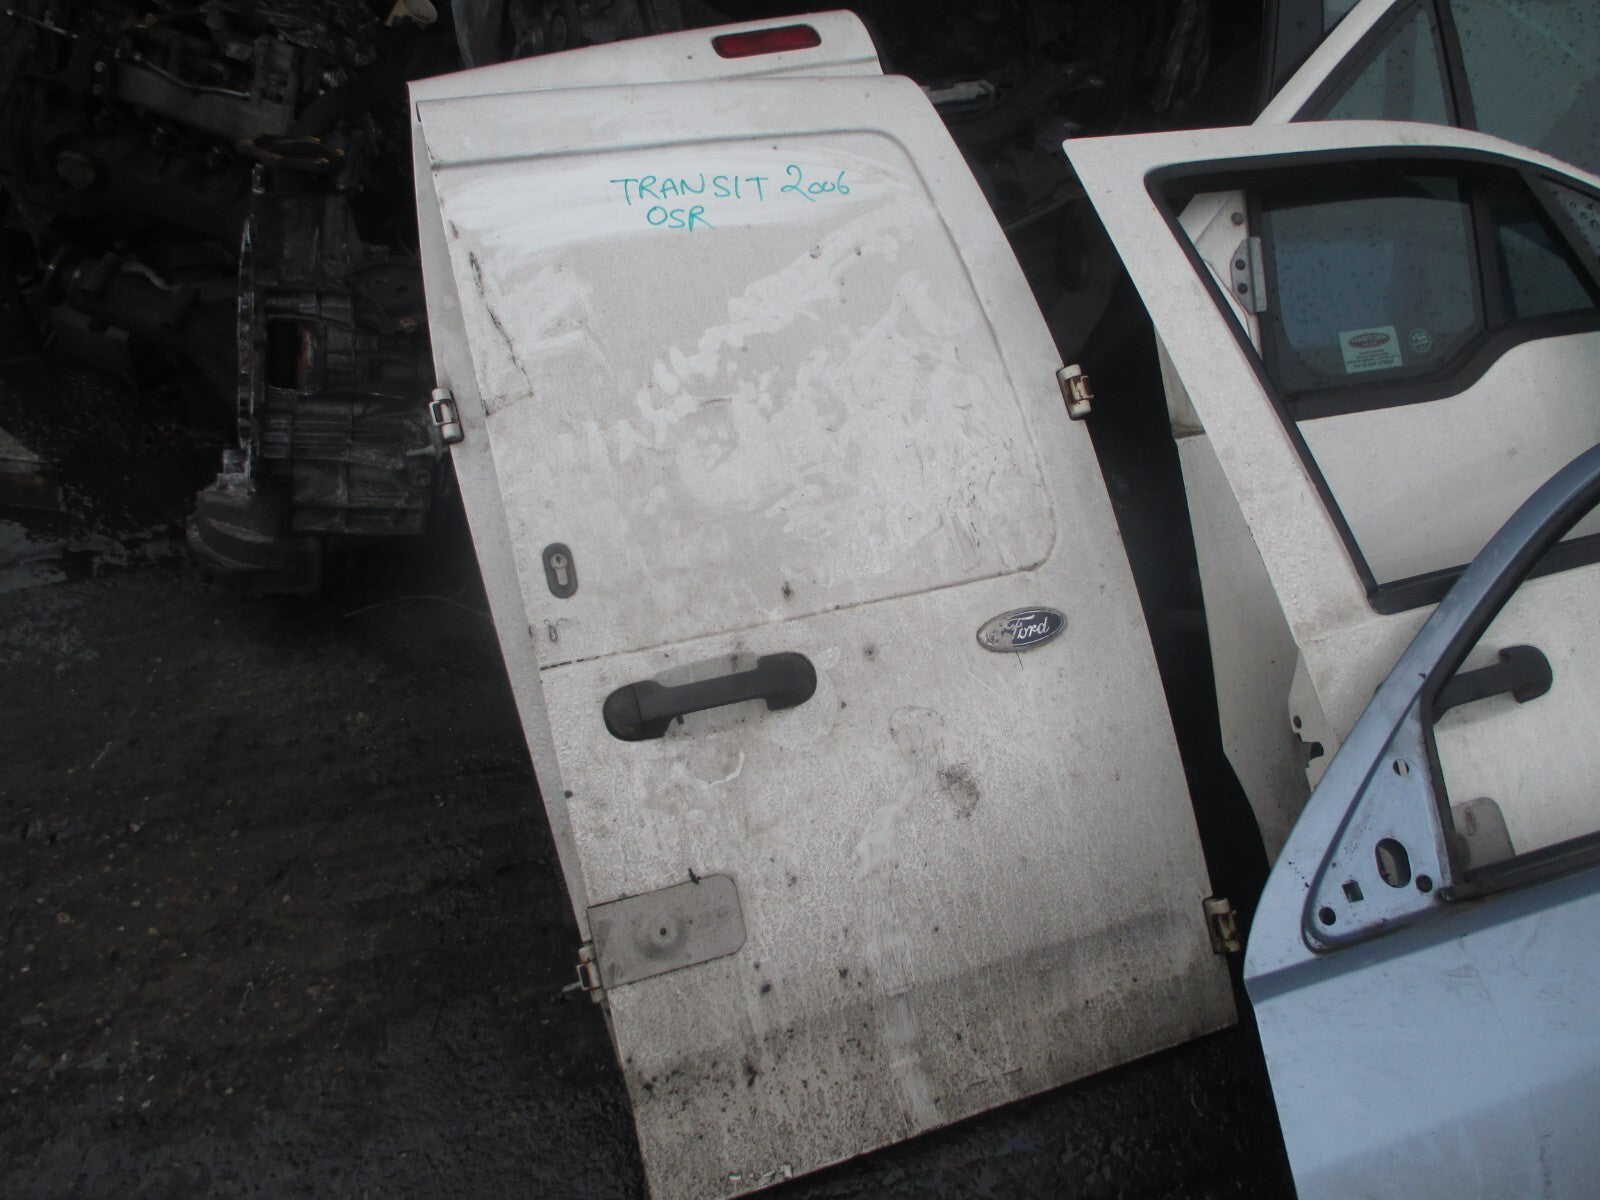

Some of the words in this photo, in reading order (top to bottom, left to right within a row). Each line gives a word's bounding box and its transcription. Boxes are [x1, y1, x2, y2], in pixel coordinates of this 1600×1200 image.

[610, 173, 768, 205] TRANSIT
[781, 165, 850, 202] 2006
[647, 206, 716, 232] OSR
[1005, 614, 1050, 640] Ford
